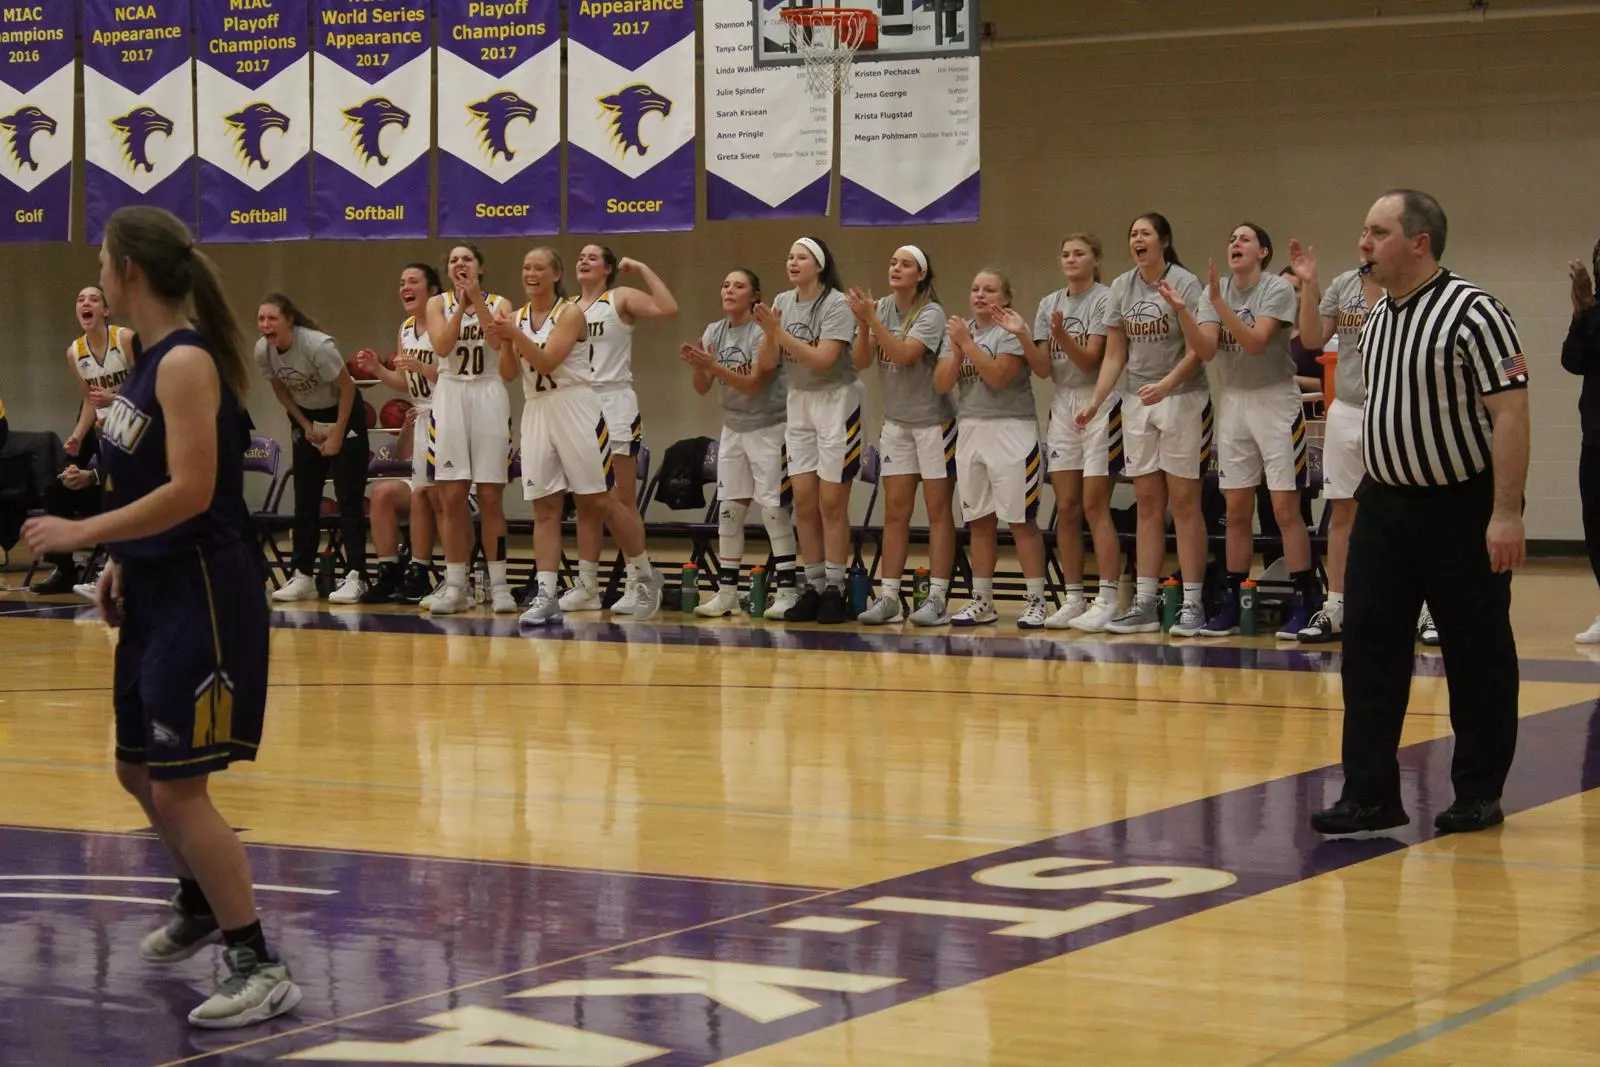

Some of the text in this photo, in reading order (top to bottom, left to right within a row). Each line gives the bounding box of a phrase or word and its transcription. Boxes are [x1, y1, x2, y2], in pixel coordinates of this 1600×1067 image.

[4, 7, 42, 21] MIAC
[115, 6, 156, 20] NCAA
[322, 7, 425, 24] World Series
[469, 0, 528, 19] Playoff
[579, 0, 684, 17] Appearance
[223, 14, 280, 33] Playoff
[612, 21, 650, 36] 2017
[715, 21, 745, 29] Shannon
[0, 28, 64, 43] ampions
[92, 26, 181, 46] Appearance
[453, 22, 546, 41] Champions
[209, 36, 297, 54] Champions
[326, 31, 422, 48] Appearance
[8, 50, 40, 63] 2016
[121, 49, 153, 62] 2017
[481, 46, 517, 60] 2017
[716, 45, 736, 54] Tanya
[236, 59, 269, 73] 2017
[356, 53, 389, 67] 2017
[716, 66, 735, 75] Linda
[855, 69, 881, 77] Kristen
[884, 67, 920, 76] Pechacek
[735, 88, 765, 96] Spindler
[855, 91, 877, 99] Jenna
[880, 90, 907, 98] George
[717, 110, 738, 118] Sarah
[855, 112, 878, 120] Krista
[880, 111, 912, 120] Flugstad
[738, 131, 764, 139] Pringle
[855, 133, 880, 142] Megan
[717, 153, 738, 161] Greta
[345, 205, 404, 220] Softball
[475, 203, 530, 218] Soccer
[606, 198, 663, 213] Soccer
[15, 209, 44, 223] Golf
[230, 208, 287, 224] Softball
[456, 346, 485, 376] 20
[1240, 594, 1252, 610] G
